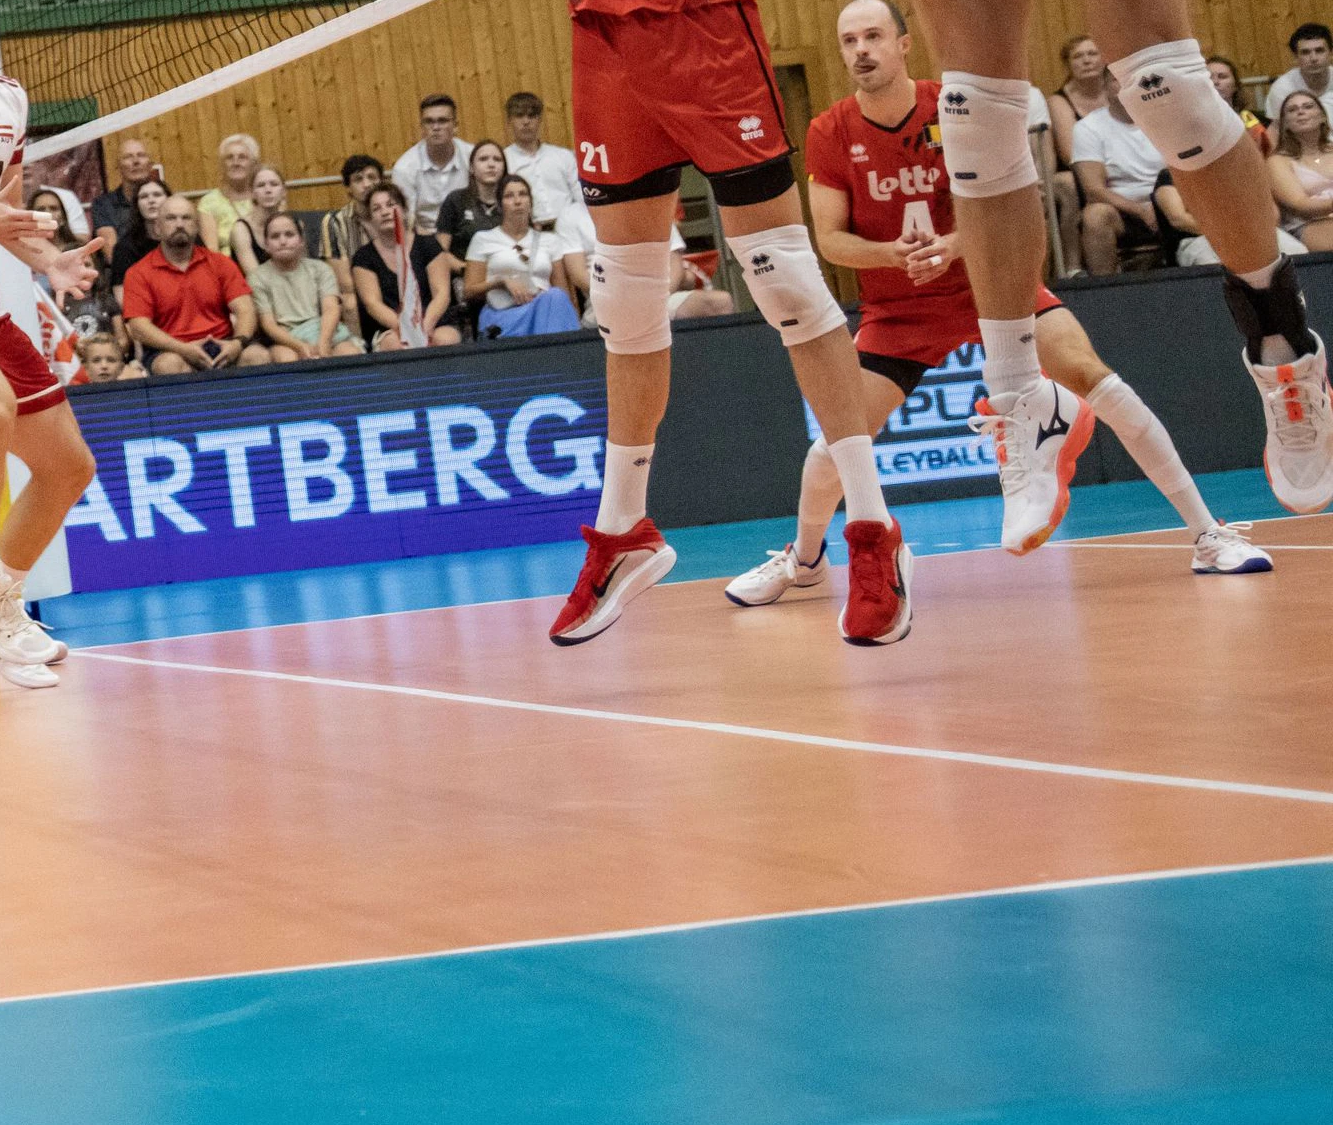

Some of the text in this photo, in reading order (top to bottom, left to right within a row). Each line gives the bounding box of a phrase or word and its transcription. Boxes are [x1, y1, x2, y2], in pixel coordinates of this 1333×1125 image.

[579, 141, 610, 173] 21
[64, 393, 604, 545] ARTBERG
[876, 445, 995, 475] LEYBALL
